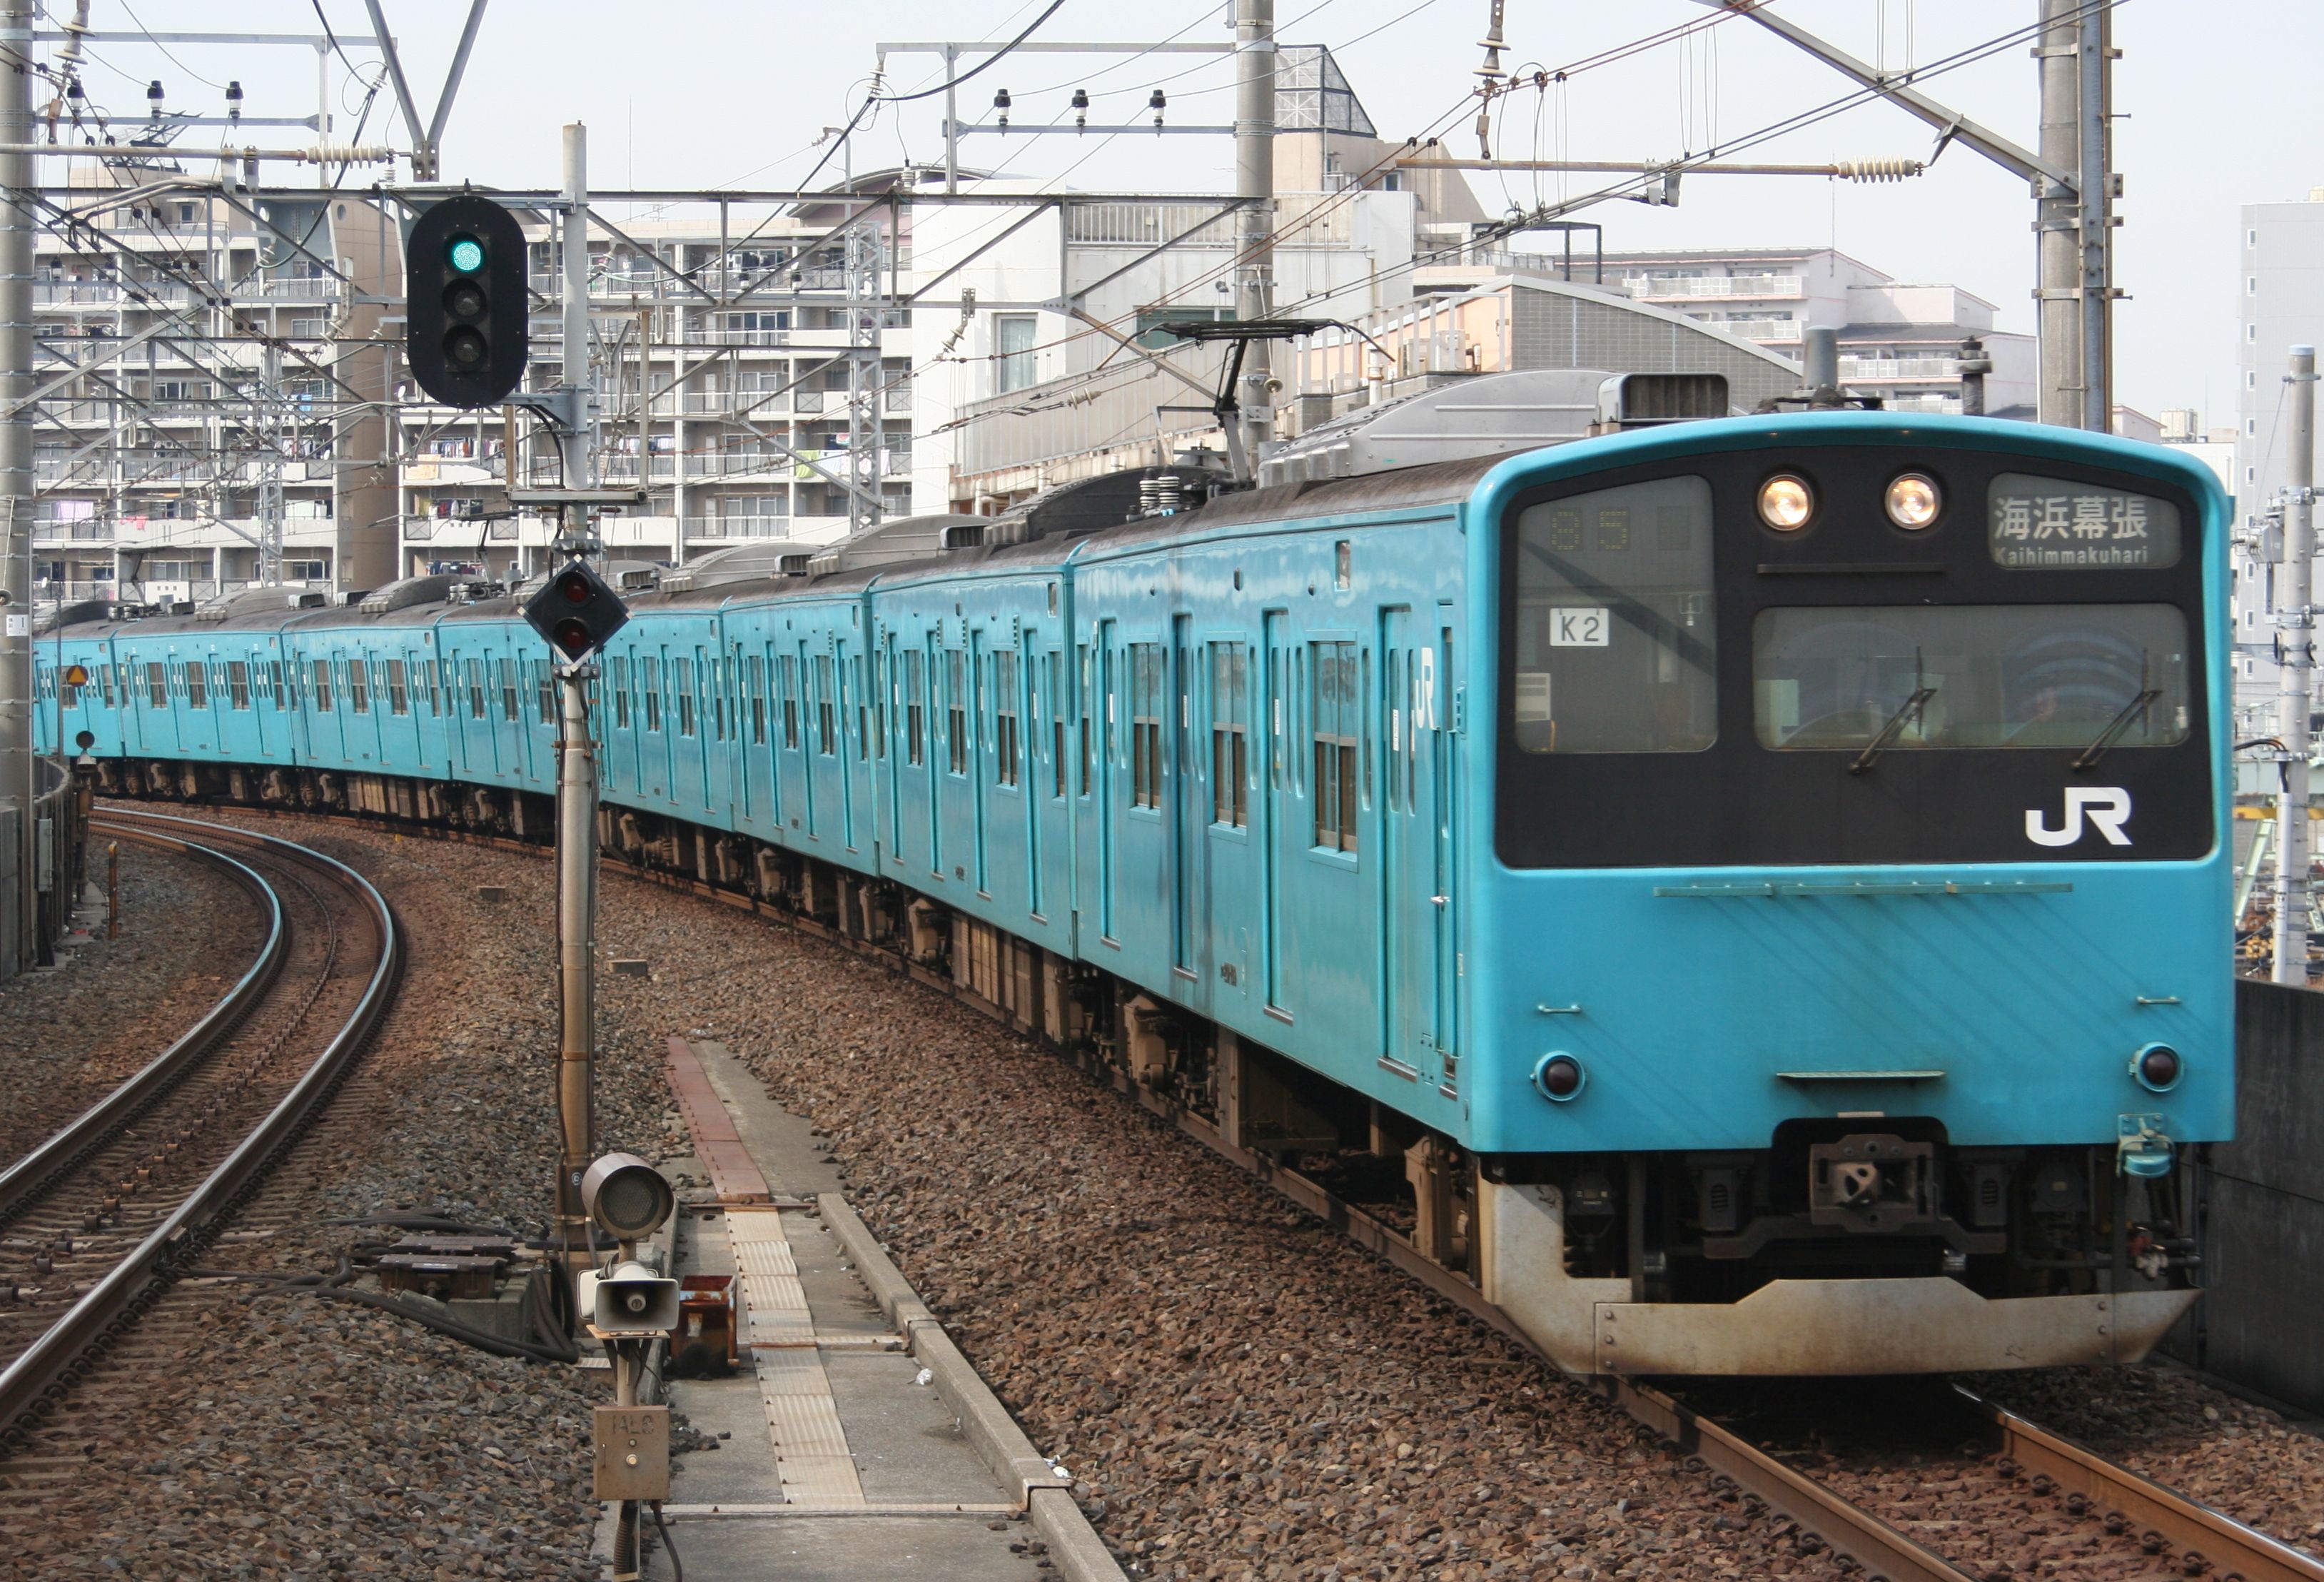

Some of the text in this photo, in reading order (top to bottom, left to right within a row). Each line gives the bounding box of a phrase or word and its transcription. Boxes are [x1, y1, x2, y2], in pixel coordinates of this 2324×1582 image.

[1994, 495, 2148, 540] 海浜幕張
[1995, 545, 2148, 565] Kaihimmakuhari
[1561, 615, 1600, 643] K2
[1415, 647, 1434, 730] JR
[2025, 787, 2133, 847] JR
